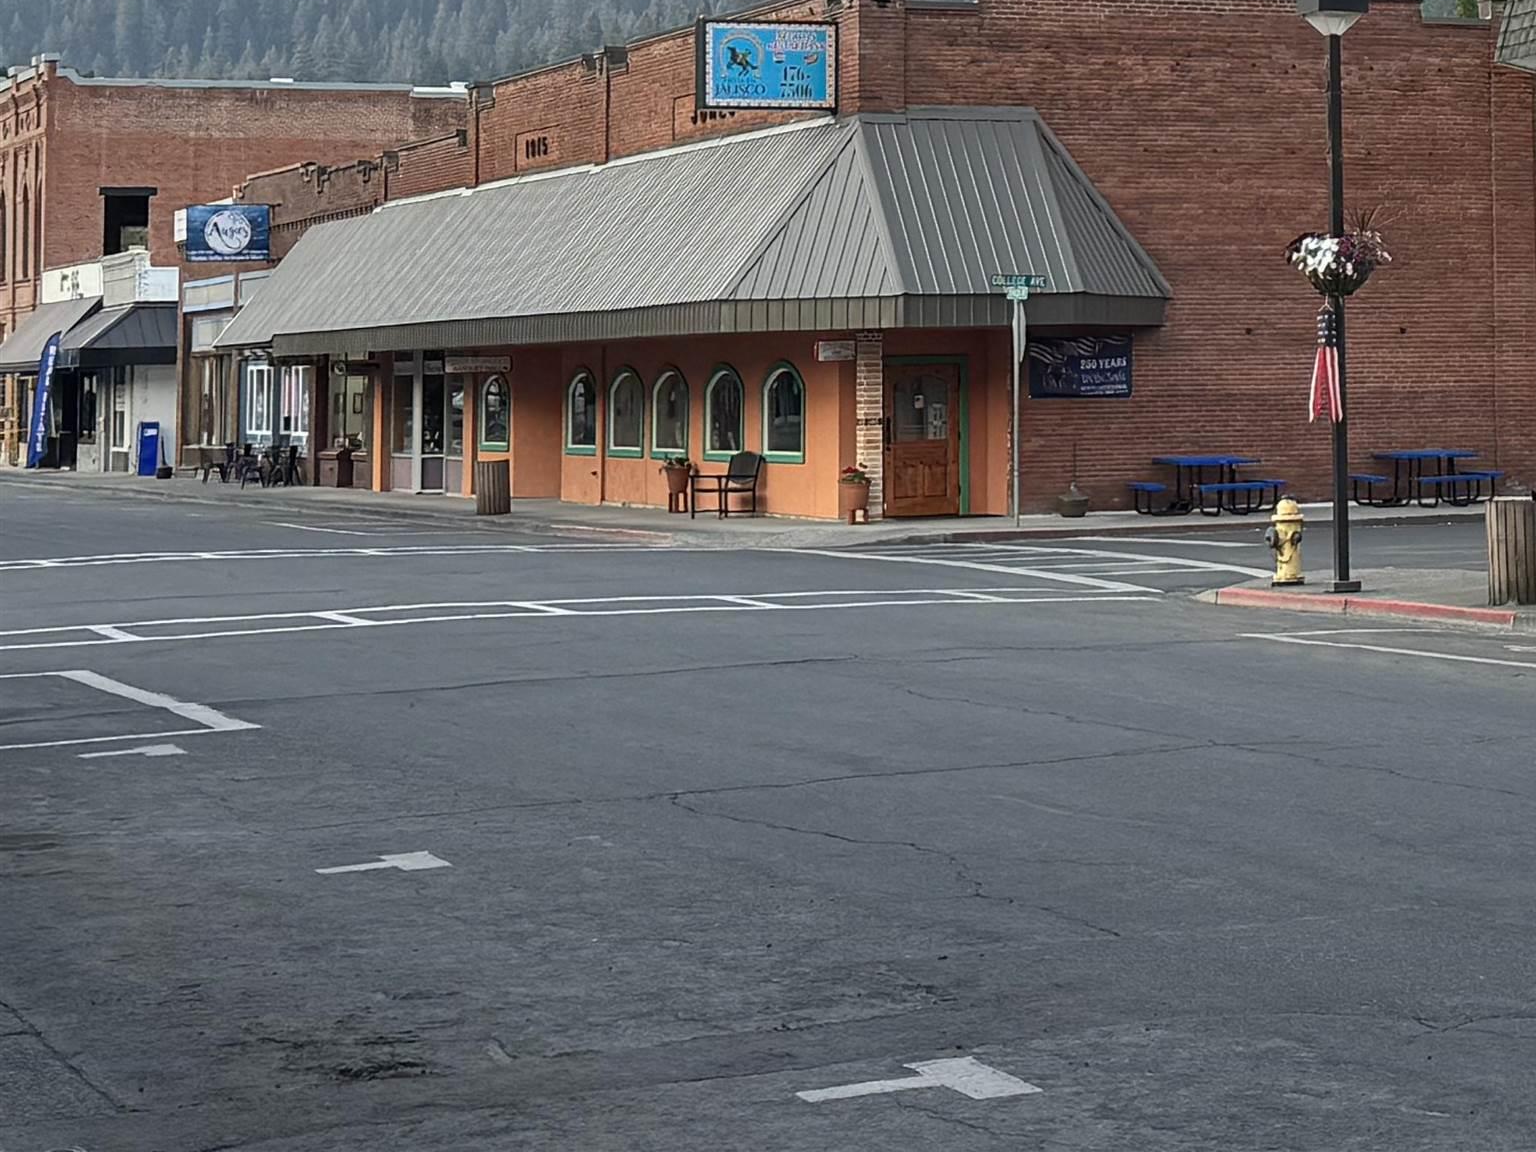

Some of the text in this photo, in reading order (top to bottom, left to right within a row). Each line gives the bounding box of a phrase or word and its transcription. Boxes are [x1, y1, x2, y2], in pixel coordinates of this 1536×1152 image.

[991, 275, 1046, 287] COLLEGE AVE
[1098, 356, 1128, 369] YEARS
